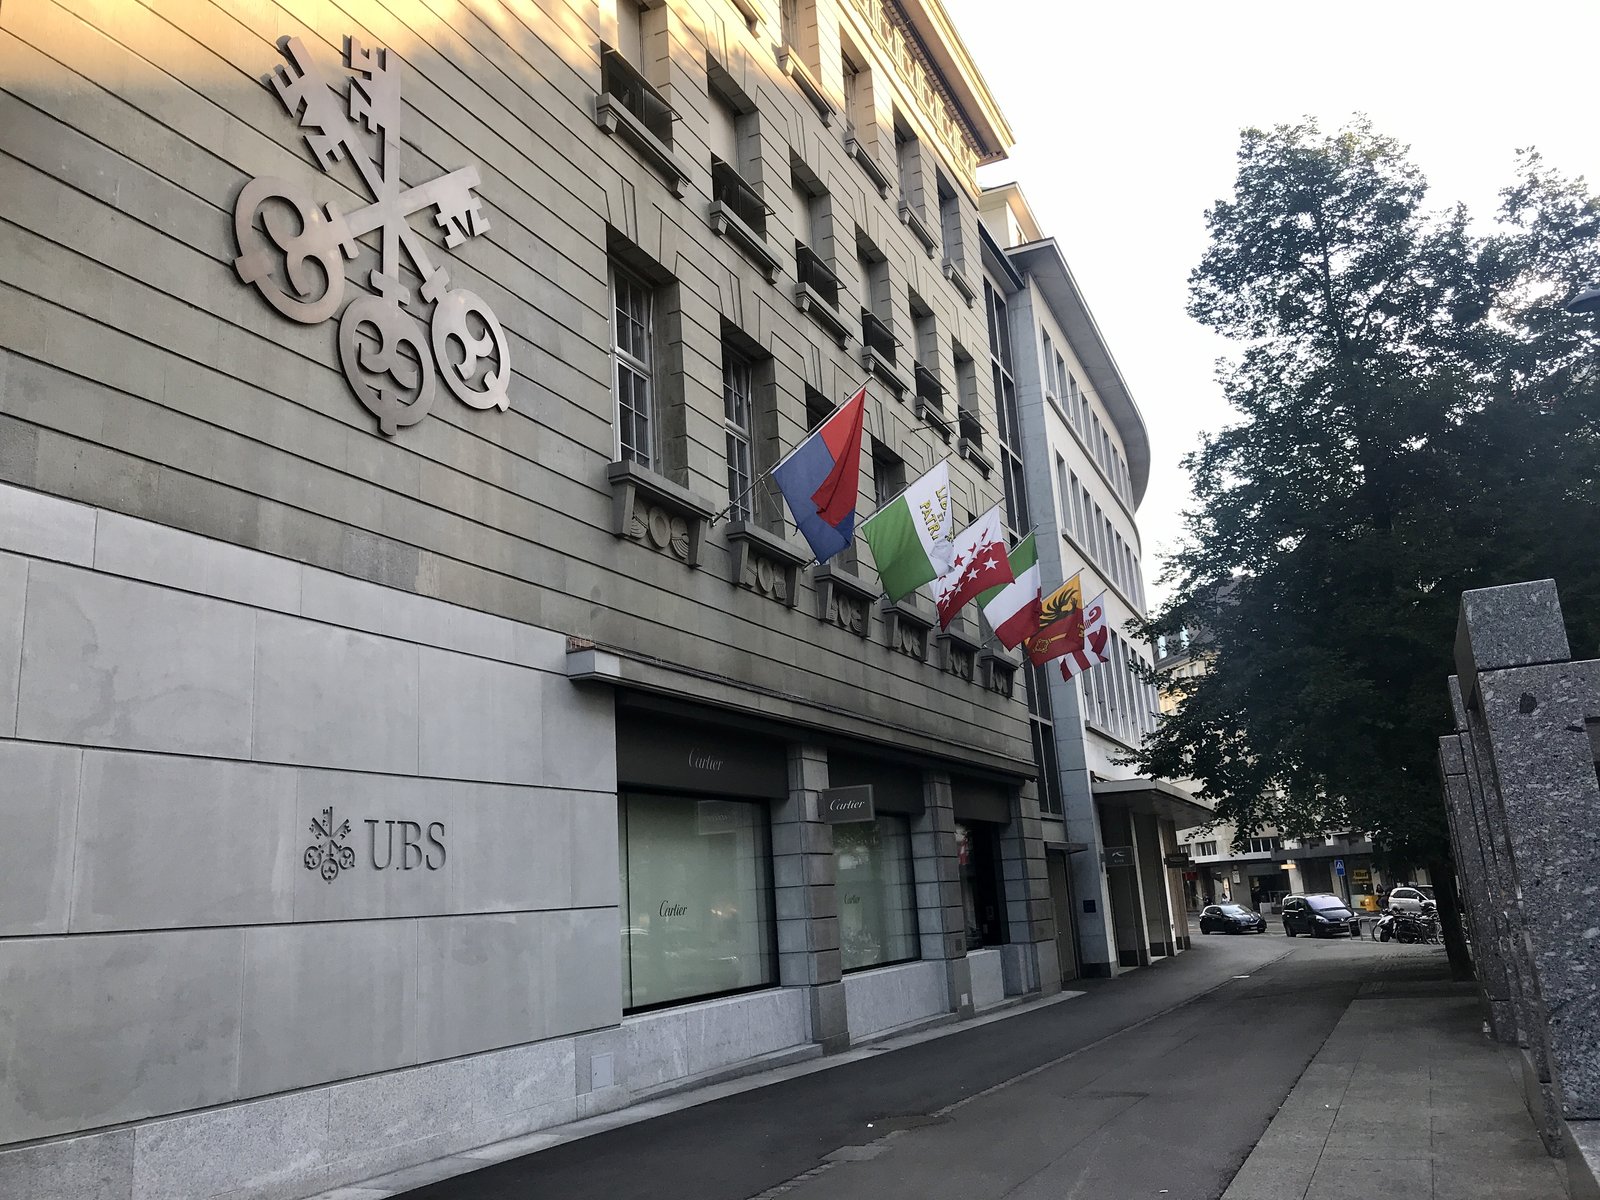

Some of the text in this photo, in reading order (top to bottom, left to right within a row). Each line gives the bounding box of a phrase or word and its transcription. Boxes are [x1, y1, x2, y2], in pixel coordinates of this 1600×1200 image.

[688, 748, 724, 771] Cartier
[829, 798, 865, 811] Cartier
[364, 819, 447, 871] UBS
[659, 899, 688, 917] Cartier
